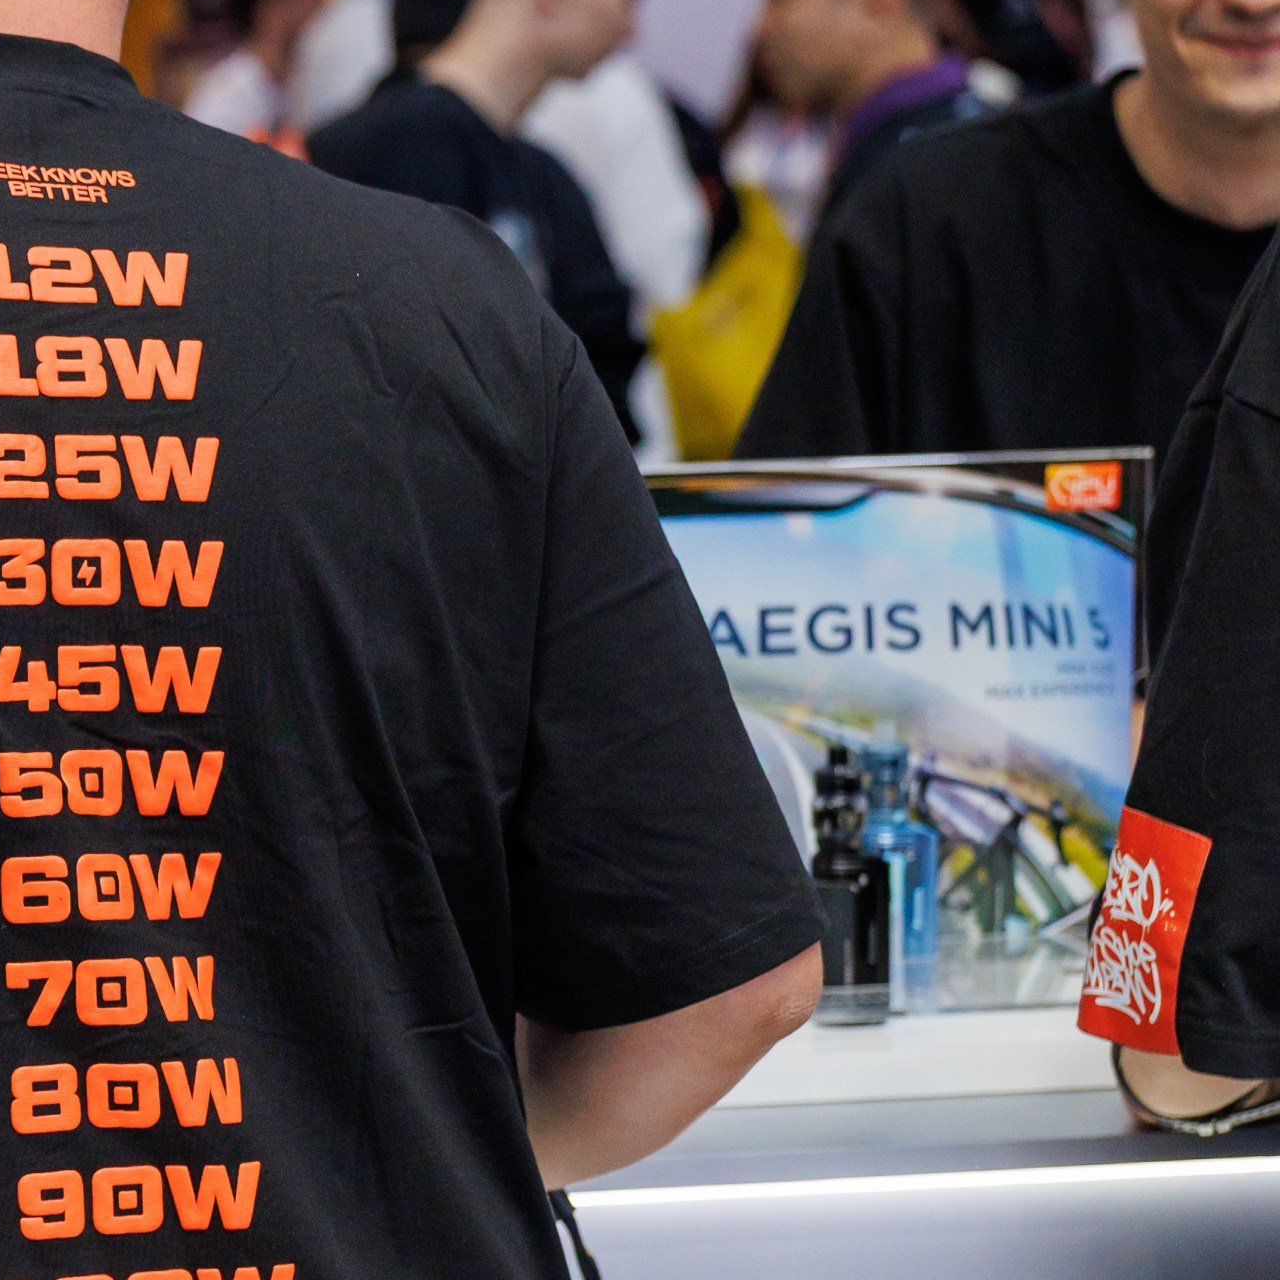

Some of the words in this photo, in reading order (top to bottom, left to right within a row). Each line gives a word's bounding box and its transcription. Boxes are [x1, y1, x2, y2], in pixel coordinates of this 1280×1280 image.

[8, 180, 108, 204] BETTER
[40, 166, 136, 188] KNOWS
[710, 599, 922, 658] AEGIS
[950, 601, 1075, 651] MINI
[0, 851, 223, 924] 60W
[5, 955, 215, 1027] 70W
[10, 1057, 243, 1135] 80W
[17, 1160, 261, 1241] 90W
